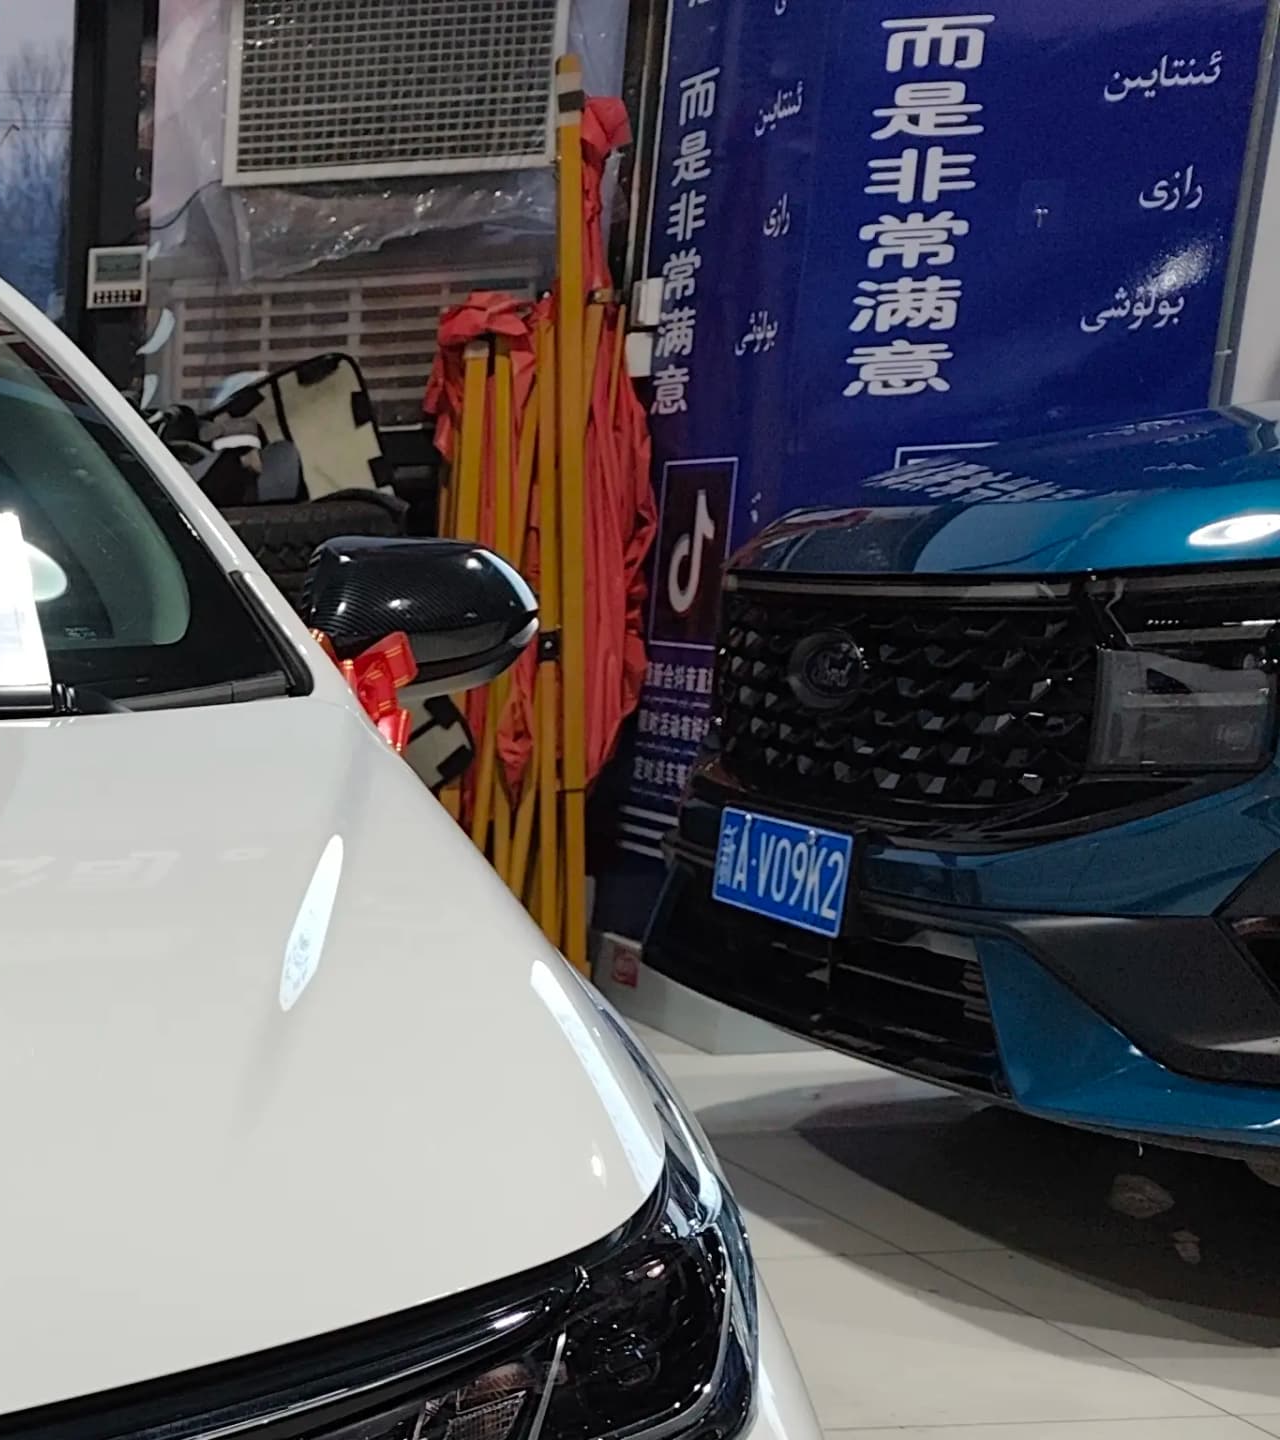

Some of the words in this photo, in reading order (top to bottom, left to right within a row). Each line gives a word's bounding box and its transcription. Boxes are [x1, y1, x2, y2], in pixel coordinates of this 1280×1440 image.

[650, 67, 720, 416] 而是非常满意
[842, 14, 995, 398] 而是非常满意
[1138, 164, 1203, 211] رازى
